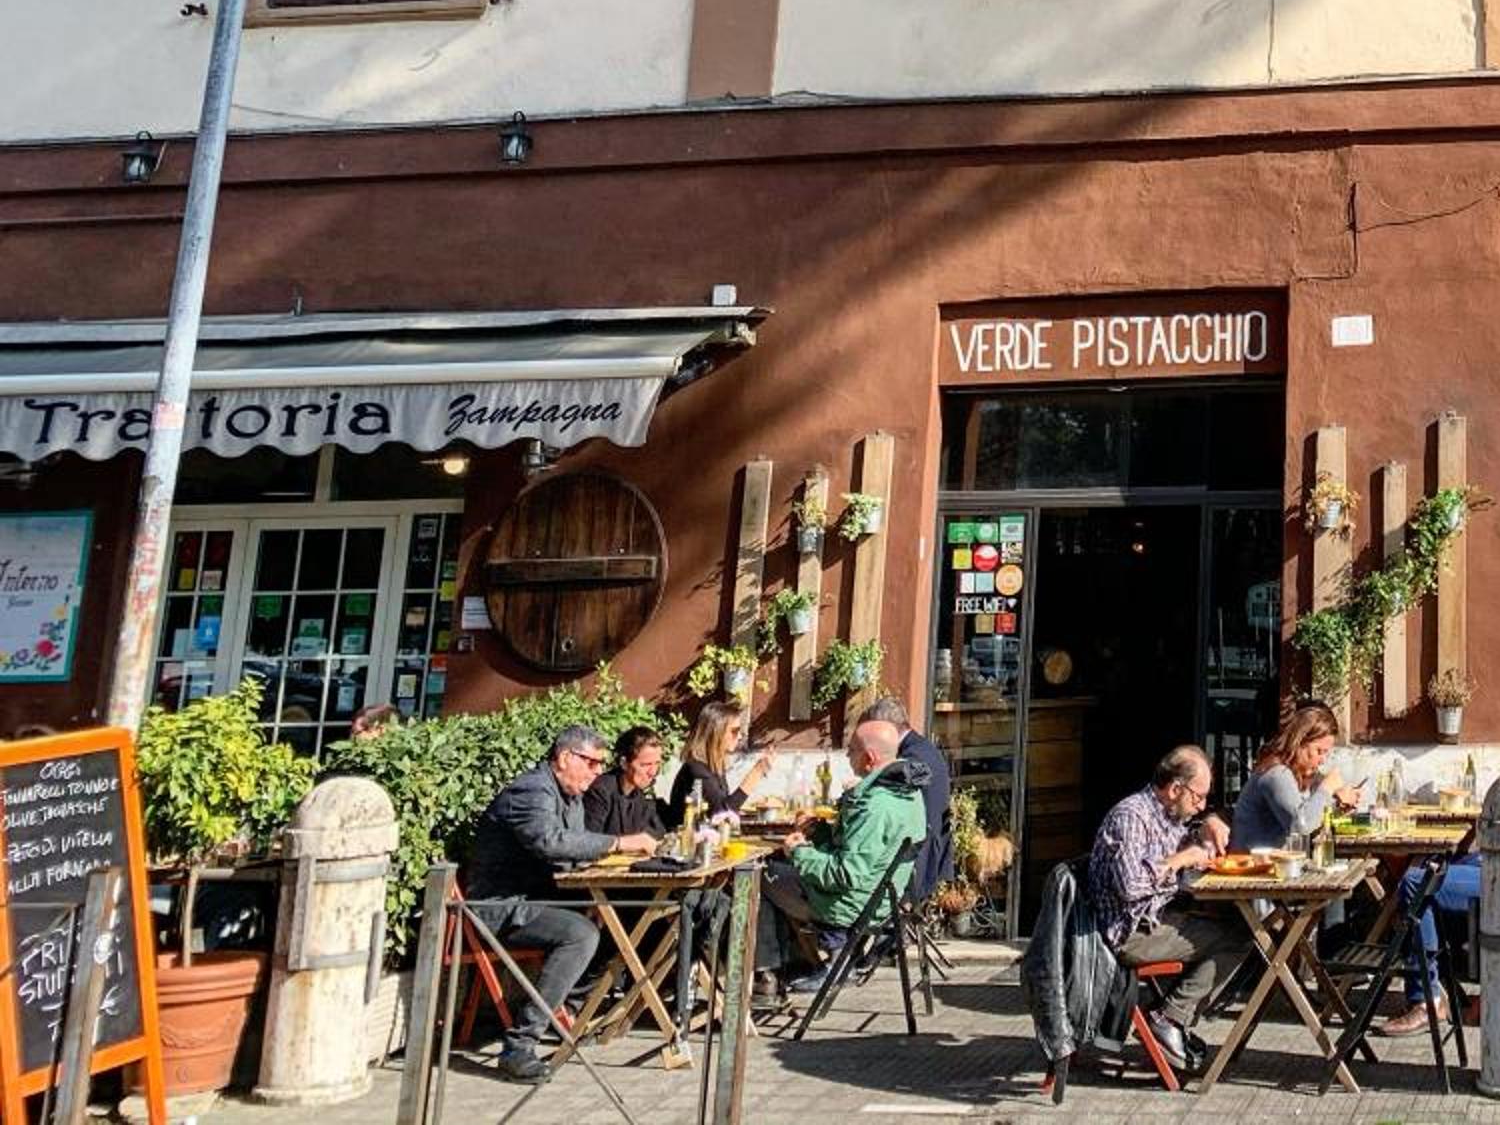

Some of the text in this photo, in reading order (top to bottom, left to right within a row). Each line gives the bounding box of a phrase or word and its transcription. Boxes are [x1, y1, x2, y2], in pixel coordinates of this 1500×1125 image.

[950, 310, 1267, 372] VERDE PISTACCHIO
[24, 392, 622, 444] Tratoria Zampagna
